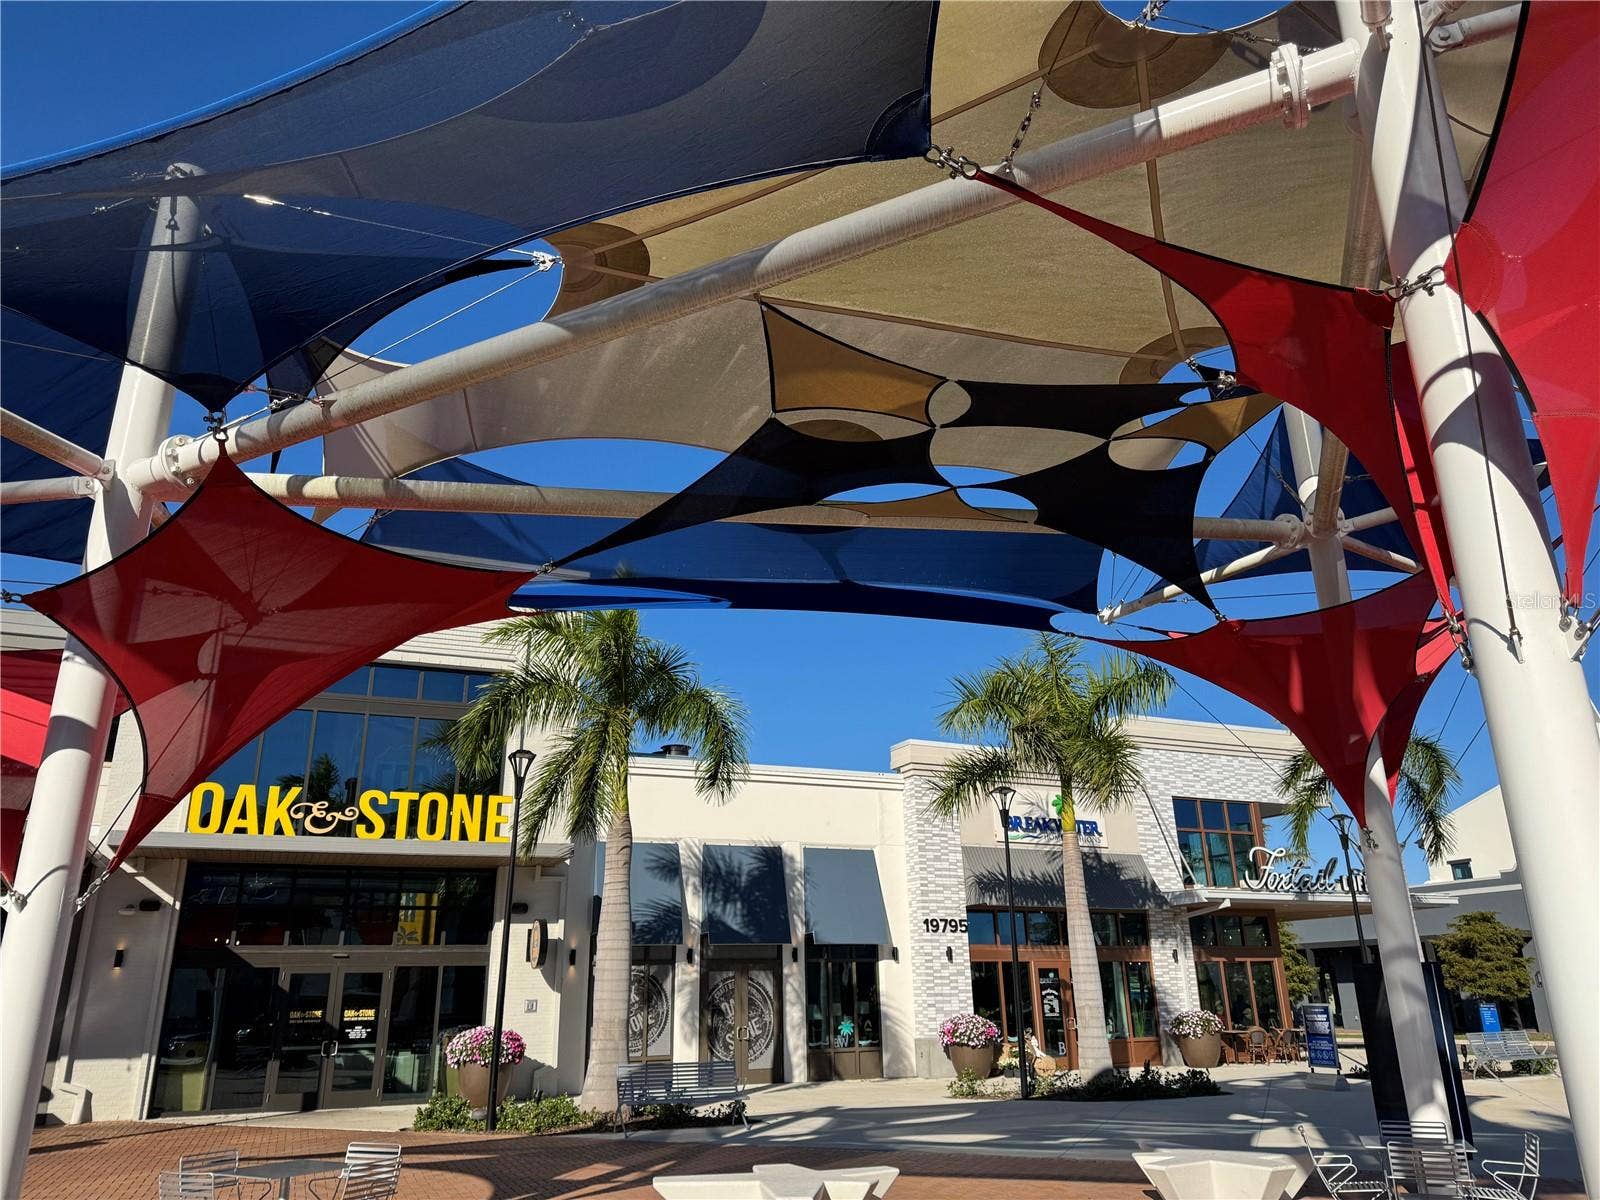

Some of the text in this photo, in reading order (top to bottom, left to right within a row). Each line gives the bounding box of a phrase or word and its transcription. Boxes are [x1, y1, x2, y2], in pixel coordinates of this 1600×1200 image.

[187, 781, 514, 843] OAK & STONE
[1245, 846, 1338, 891] Foxtail
[923, 918, 968, 933] 19795
